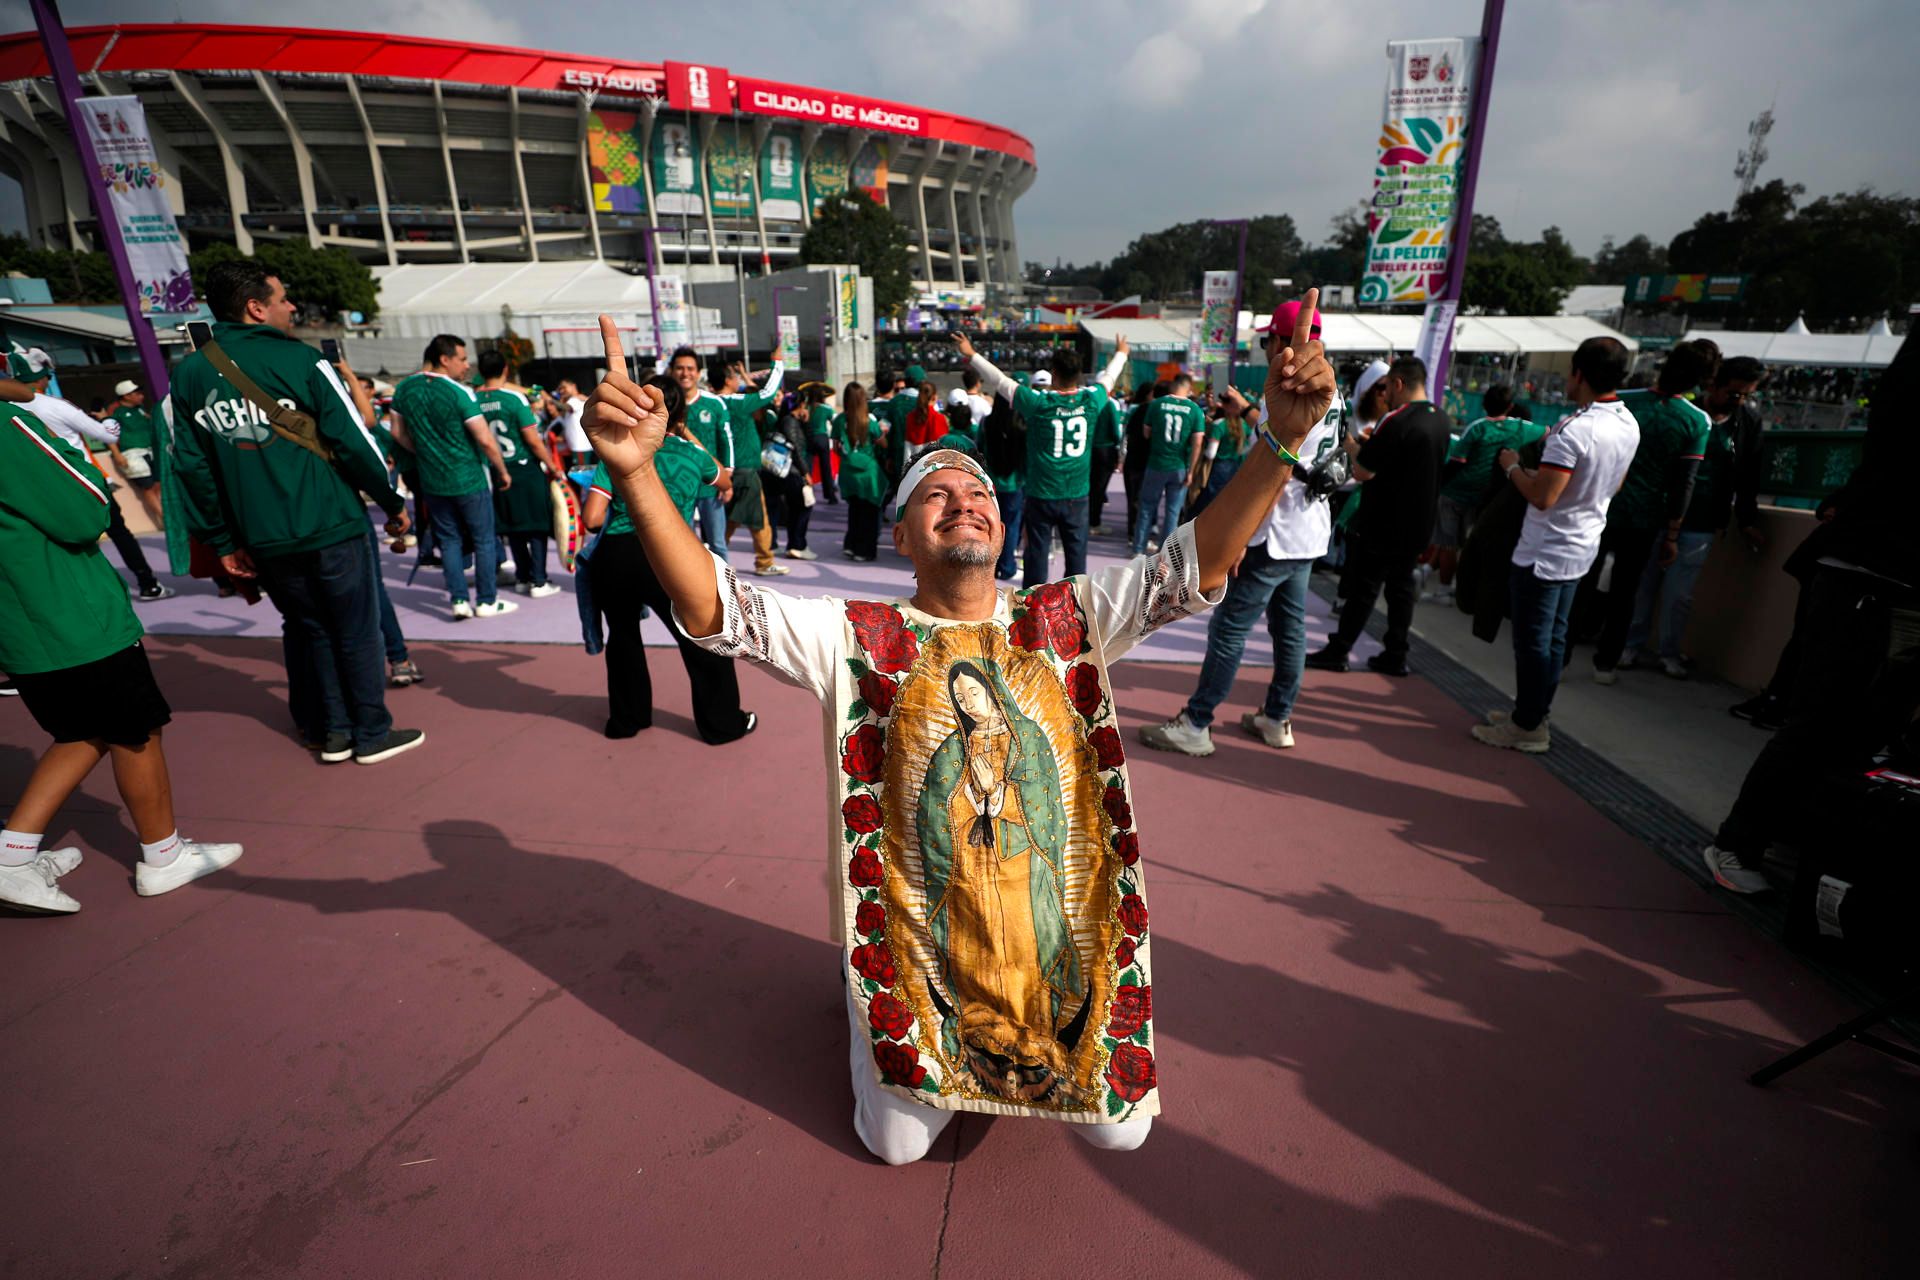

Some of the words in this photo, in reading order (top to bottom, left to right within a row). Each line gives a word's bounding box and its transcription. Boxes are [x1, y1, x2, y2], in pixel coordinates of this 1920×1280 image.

[565, 69, 656, 93] ESTADIO
[753, 91, 825, 115] CIUDAD
[831, 103, 856, 120] DE
[859, 107, 919, 130] MÉXICO
[1372, 247, 1390, 260] LA
[1394, 246, 1447, 260] PELOTA
[1370, 262, 1408, 272] VUELVE
[1410, 262, 1418, 271] A
[1420, 262, 1445, 271] CASA
[1051, 416, 1087, 458] 13
[1165, 413, 1183, 443] 11
